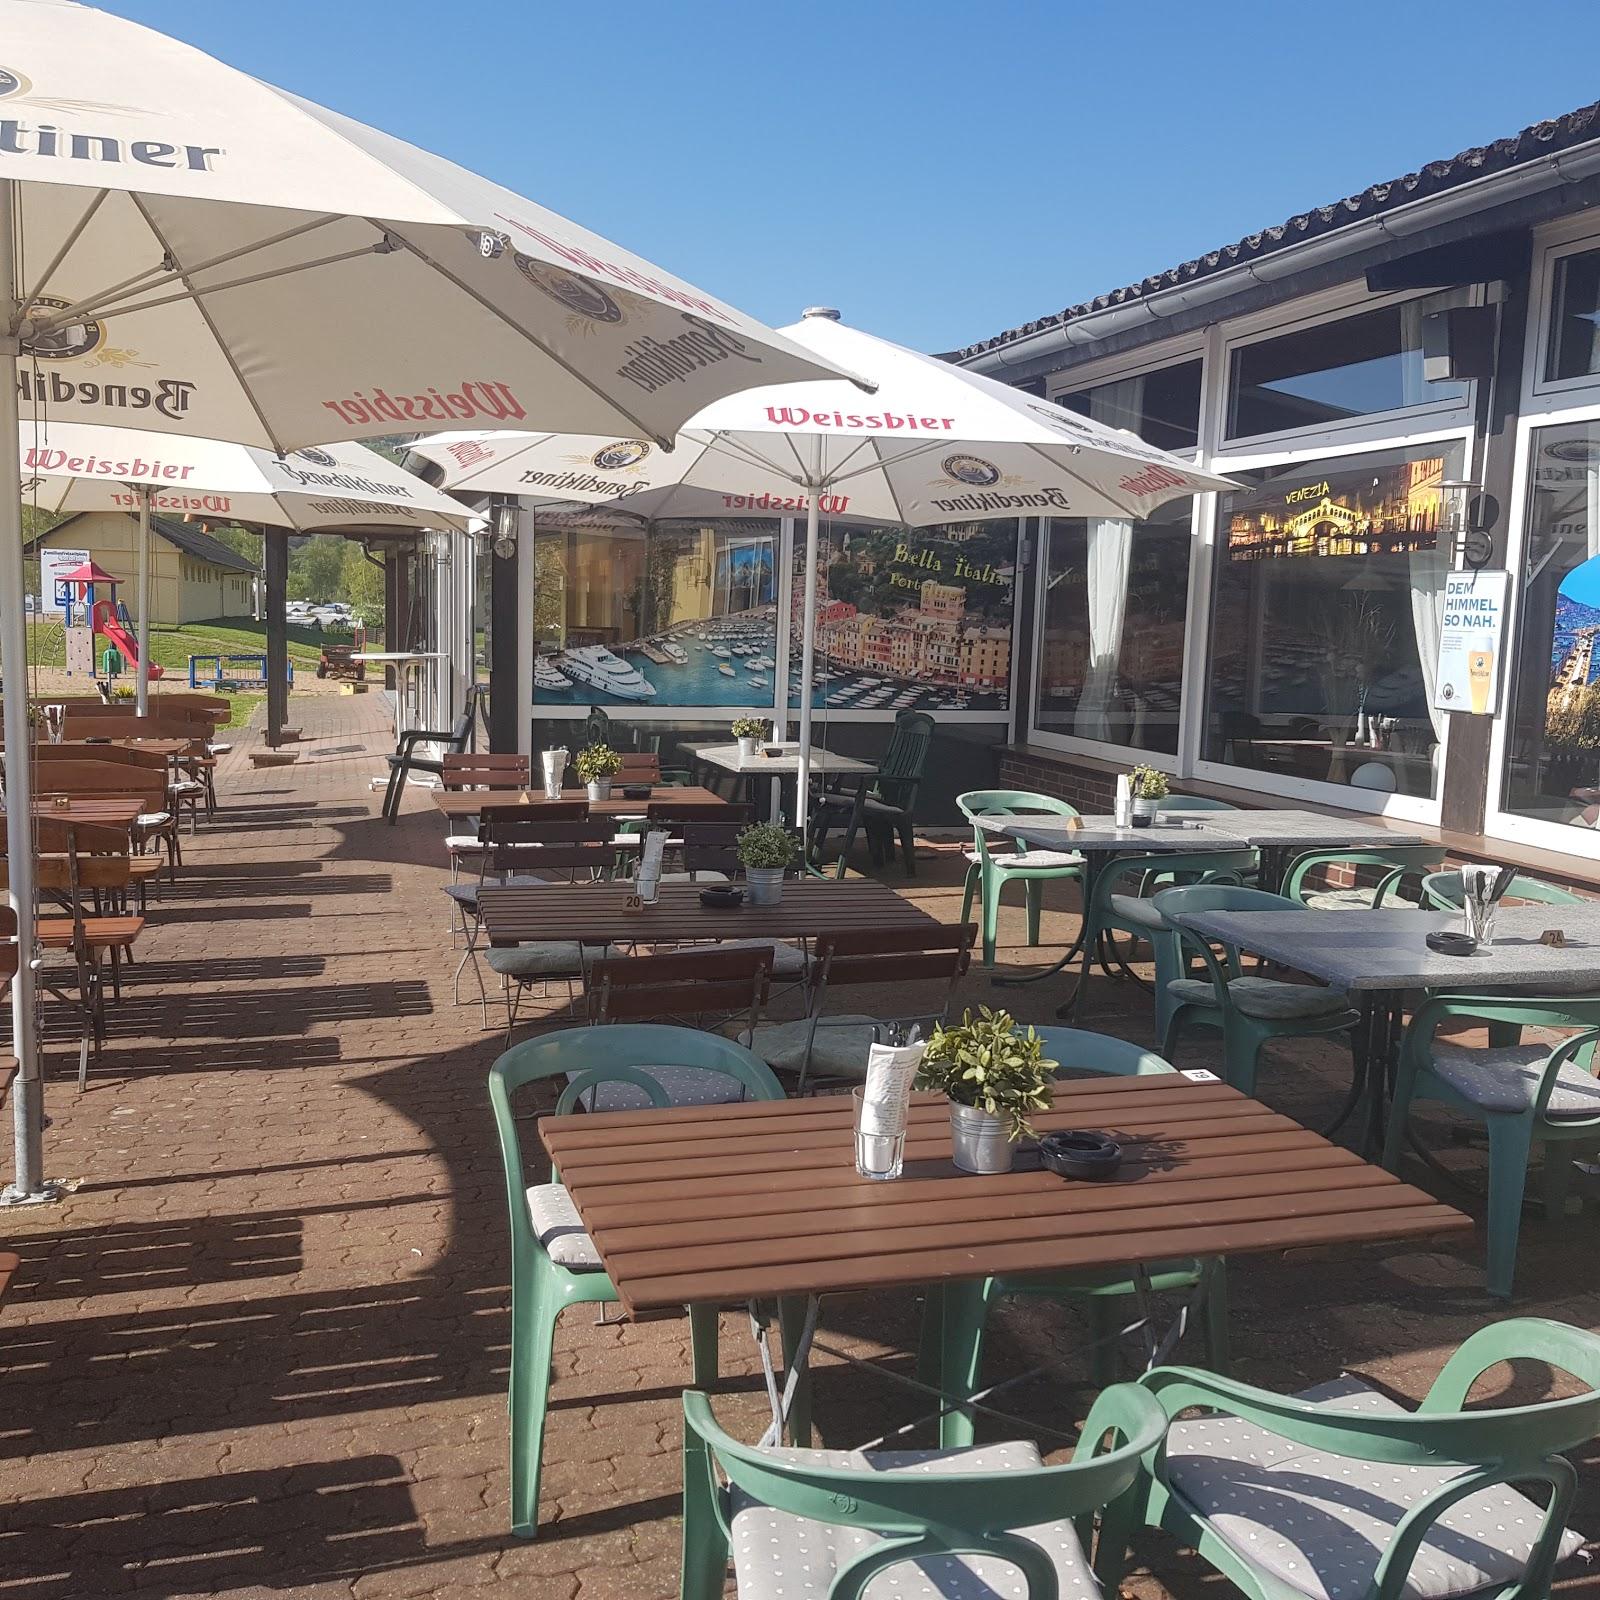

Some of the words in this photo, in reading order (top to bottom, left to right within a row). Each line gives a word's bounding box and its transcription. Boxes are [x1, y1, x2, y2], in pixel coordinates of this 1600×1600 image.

[763, 407, 956, 431] Weissbier
[24, 447, 195, 480] Weissbier
[271, 460, 415, 499] Benediktiner
[1285, 480, 1330, 505] VENEZIA
[893, 543, 942, 572] Bella
[1447, 582, 1474, 595] DEM
[1445, 598, 1498, 612] HIMMEL
[1444, 614, 1460, 627] SO
[1462, 614, 1496, 628] NAH.
[626, 896, 640, 908] 20
[1549, 932, 1562, 943] 24
